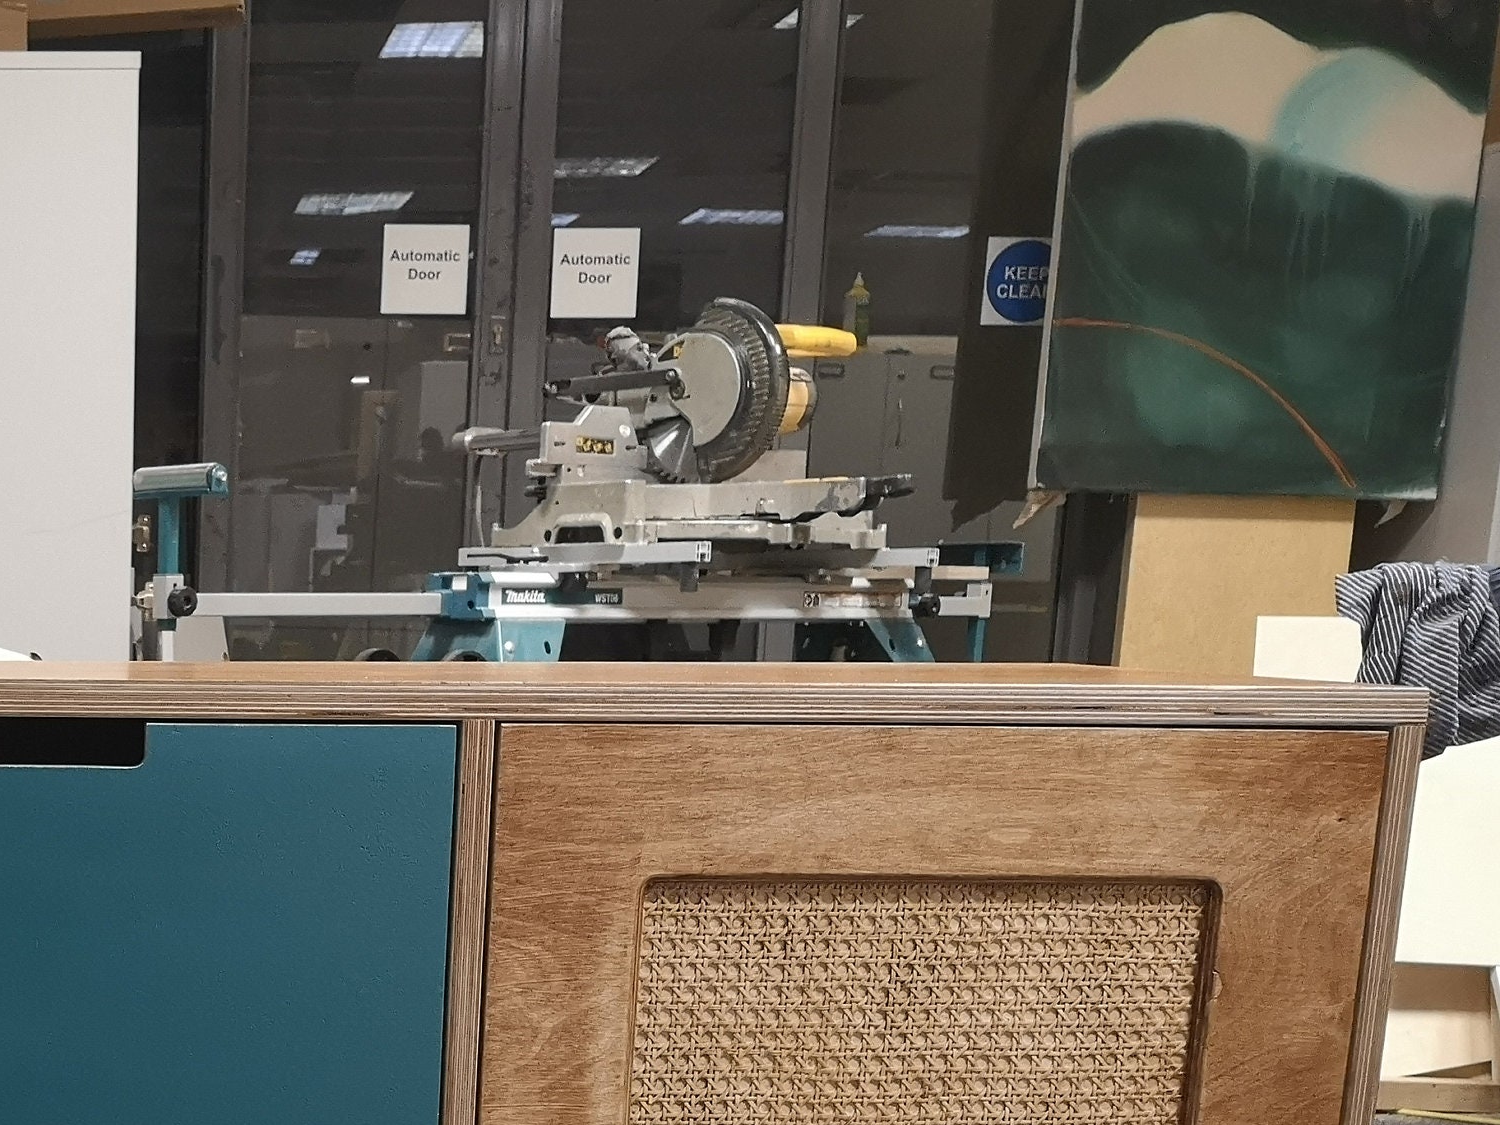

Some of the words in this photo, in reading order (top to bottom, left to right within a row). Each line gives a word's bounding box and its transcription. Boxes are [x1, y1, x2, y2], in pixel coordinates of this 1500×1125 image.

[390, 249, 461, 262] Automatic
[560, 253, 631, 266] Automatic
[408, 268, 441, 280] Door
[578, 272, 611, 284] Door
[505, 590, 546, 603] Makita
